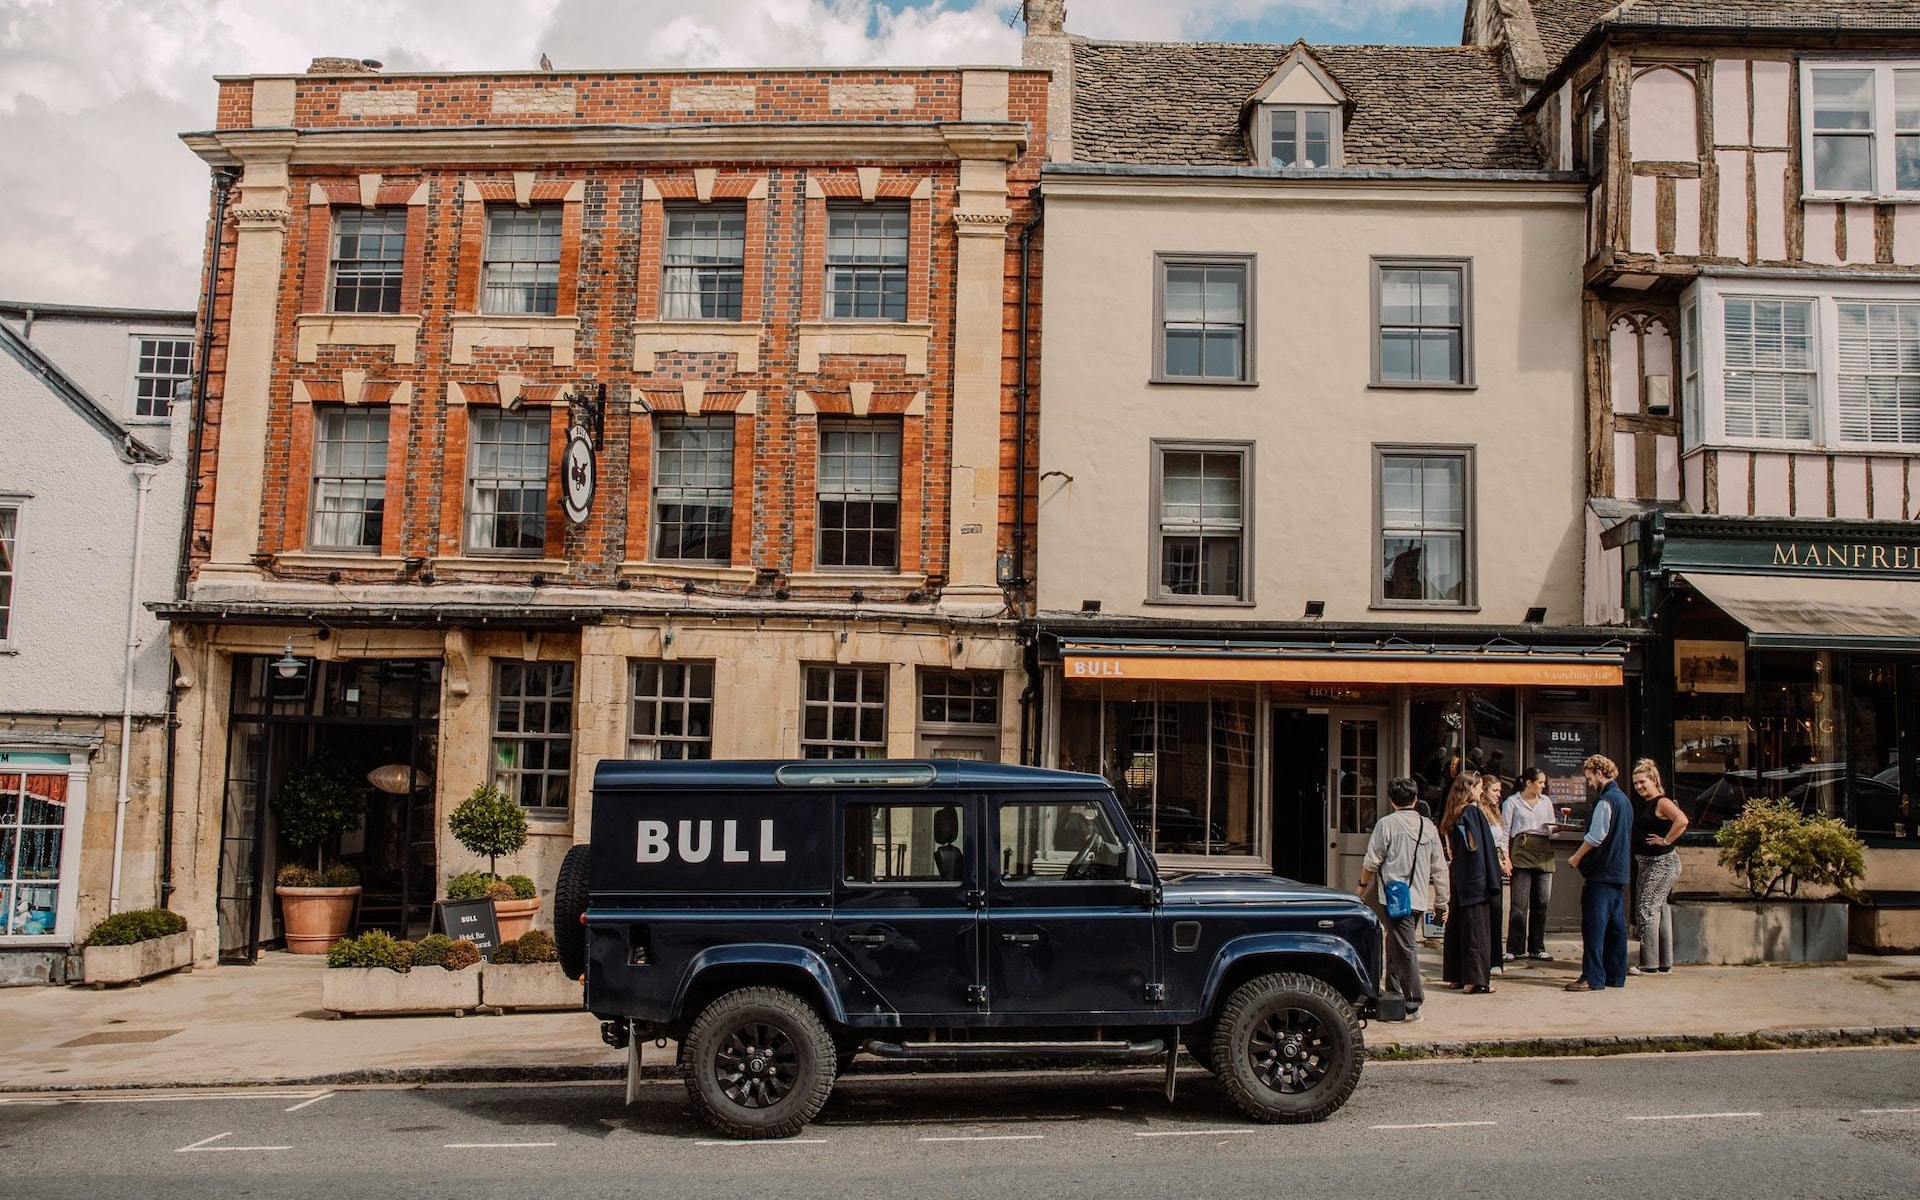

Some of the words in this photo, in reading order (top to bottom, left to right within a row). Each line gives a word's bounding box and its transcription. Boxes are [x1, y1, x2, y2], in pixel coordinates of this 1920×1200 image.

[1075, 661, 1124, 675] BULL
[1544, 669, 1592, 682] Coaching
[1552, 732, 1580, 741] BULL
[636, 819, 787, 863] BULL
[461, 915, 477, 923] BULL
